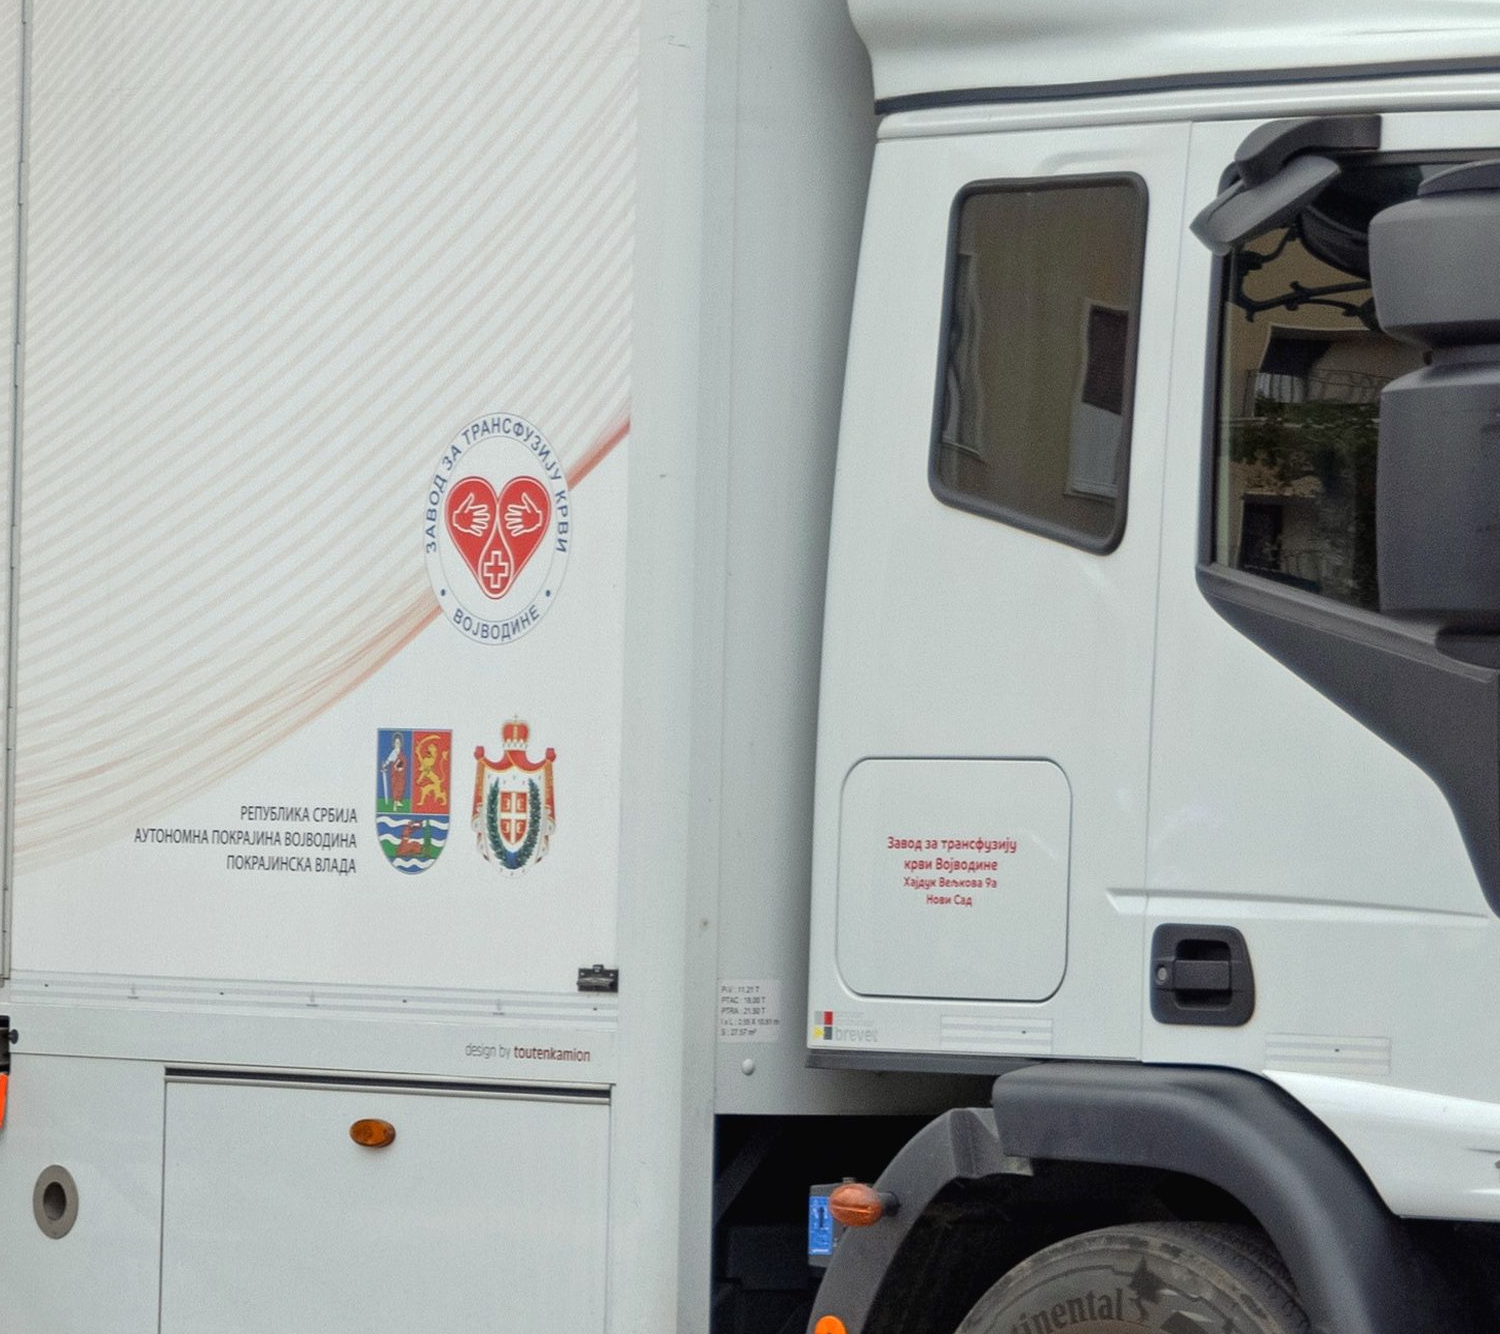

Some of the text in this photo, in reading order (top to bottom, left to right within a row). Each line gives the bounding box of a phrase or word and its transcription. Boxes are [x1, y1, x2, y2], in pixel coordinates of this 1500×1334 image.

[425, 418, 569, 554] ЗАВОД ЗА ТРАНСФУЗИЈУ КРВИ
[453, 605, 541, 640] ВОЈВОДИНЕ
[240, 805, 358, 823] РЕПУБЛИКА СРБИЈА
[133, 827, 358, 850] АУТОНОМНА ПОКРАЈИНА ВОЈВОДИНА
[887, 836, 1018, 853] Завод за трансфузију
[226, 854, 357, 876] ПОКРАЈИНСКА ВЛАДА
[903, 857, 998, 874] крви Војводине
[903, 876, 936, 890] Хајдук
[939, 876, 983, 889] Вељкова
[926, 894, 973, 907] Нови Сад
[465, 1043, 590, 1062] design by toutenkamion
